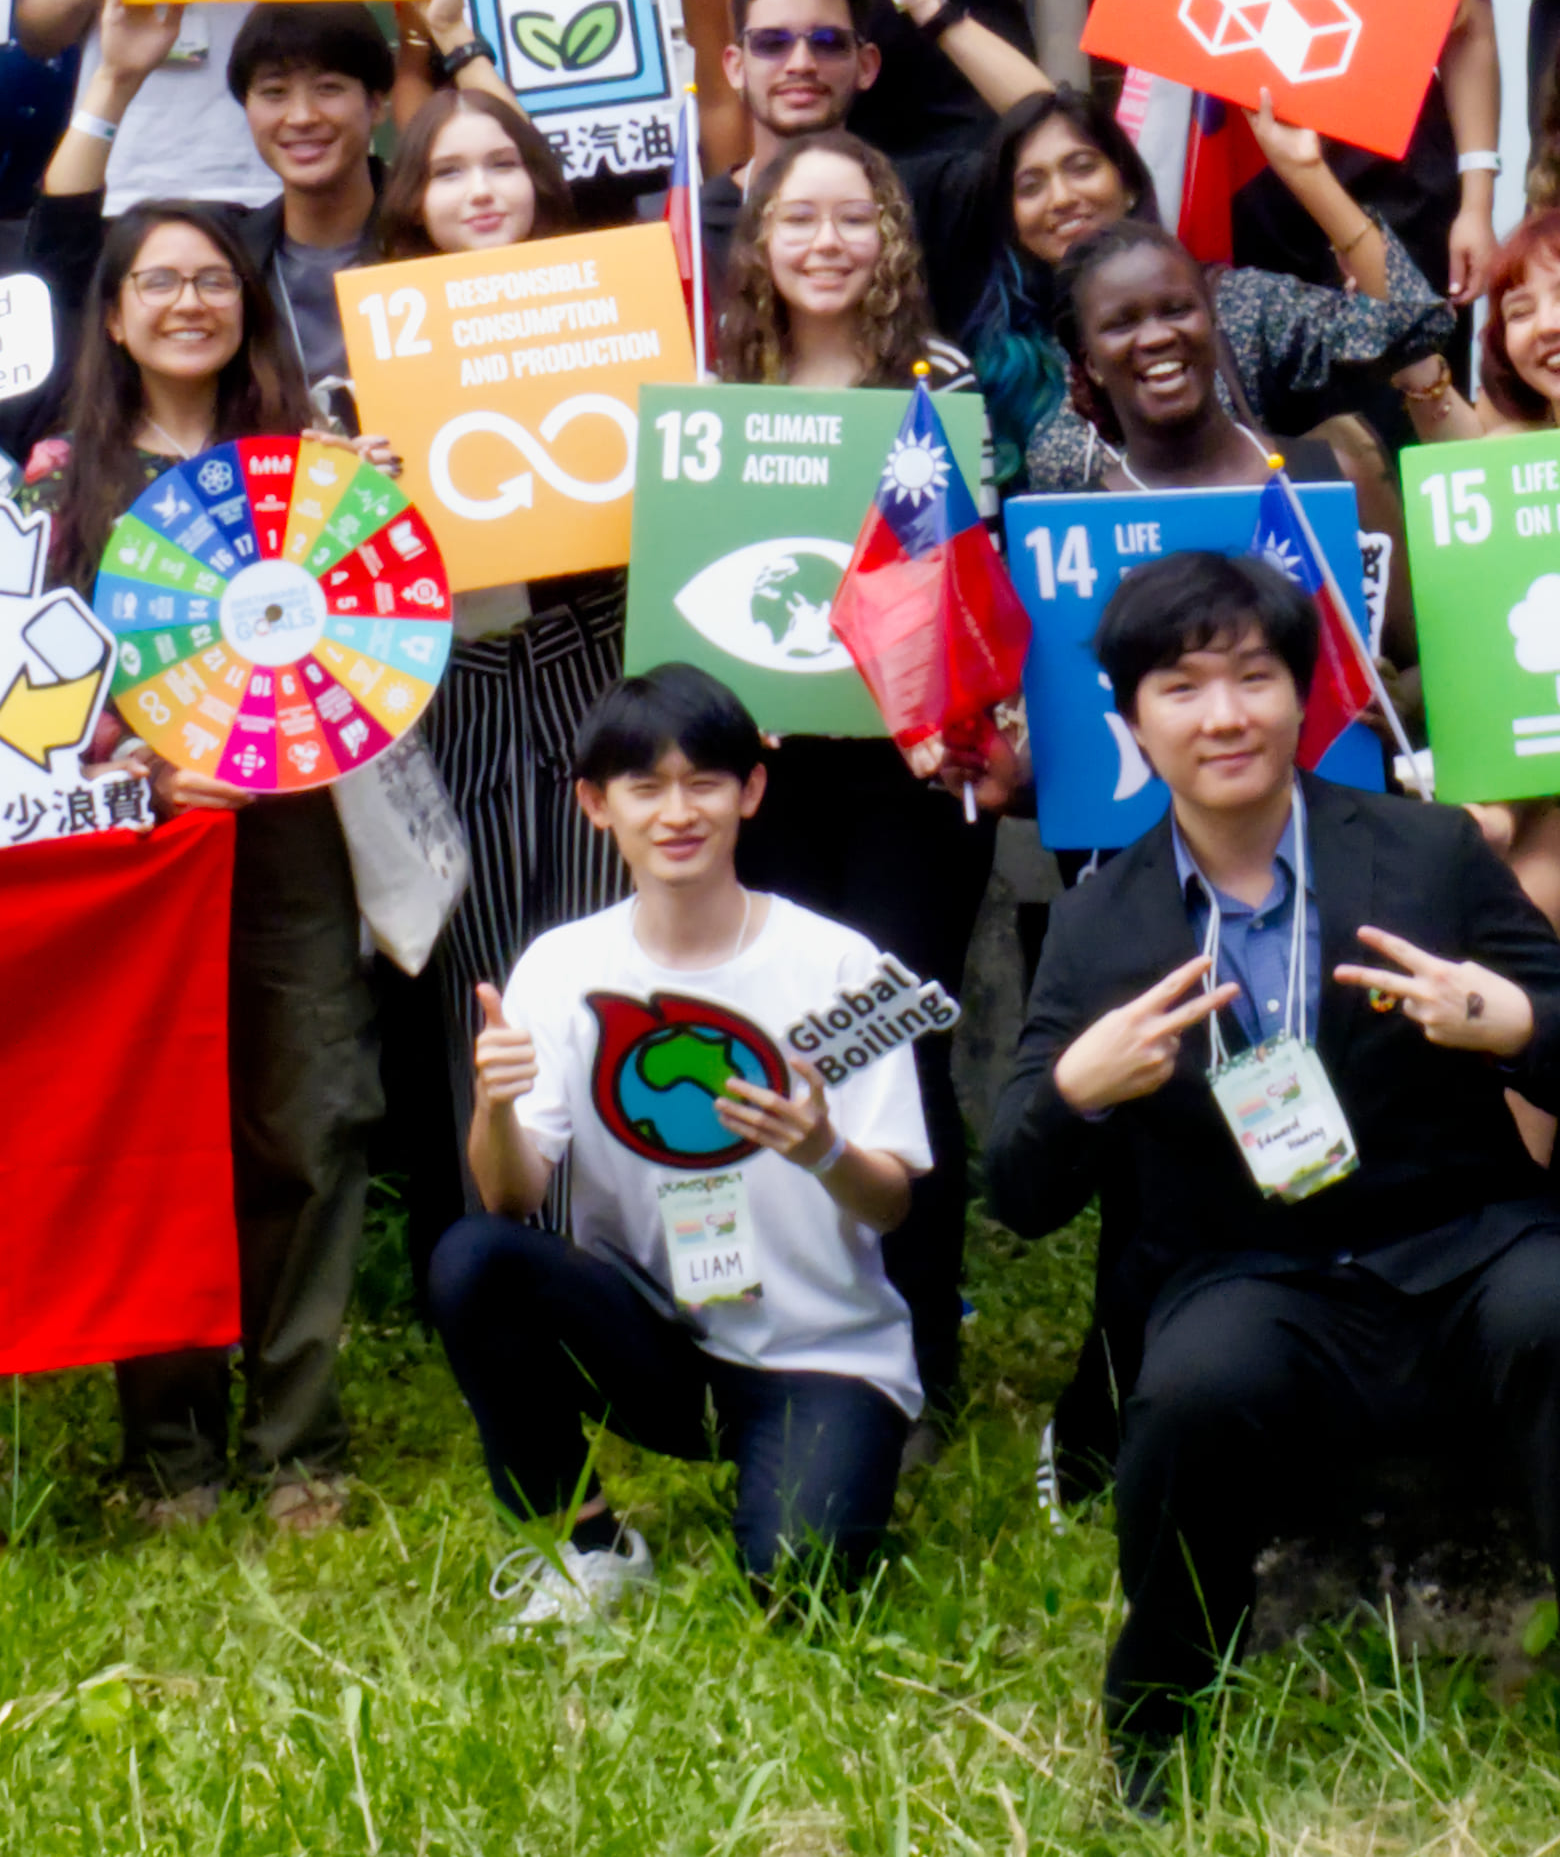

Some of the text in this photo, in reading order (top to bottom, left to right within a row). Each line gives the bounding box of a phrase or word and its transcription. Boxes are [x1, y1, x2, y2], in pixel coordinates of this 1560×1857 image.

[543, 116, 675, 172] 保汽油
[445, 260, 600, 309] RESPONSIBLE
[358, 287, 432, 360] 12
[452, 296, 619, 348] CONSUMPTION
[460, 330, 661, 387] AND PRODUCTION
[745, 413, 843, 445] CLIMATE
[655, 411, 723, 482] 13
[742, 454, 829, 486] ACTION
[1512, 460, 1560, 495] LIFE
[1420, 468, 1493, 547] 15
[1515, 504, 1552, 538] ON
[234, 533, 255, 557] 17
[267, 529, 277, 550] 1
[291, 533, 307, 554] 2
[1114, 521, 1163, 555] LIFE
[209, 548, 234, 573] 16
[313, 547, 330, 566] 3
[1025, 525, 1098, 600] 14
[194, 570, 219, 593] 15
[331, 570, 349, 586] 4
[188, 598, 209, 620] 14
[337, 595, 358, 610] 5
[190, 624, 213, 647] 13
[202, 648, 227, 672] 12
[224, 665, 246, 688] 11
[250, 675, 271, 697] 10
[282, 675, 296, 695] 9
[3, 779, 146, 842] 少浪費
[788, 962, 911, 1054] Global
[813, 992, 953, 1086] Boiling
[688, 1251, 744, 1284] LIAM
